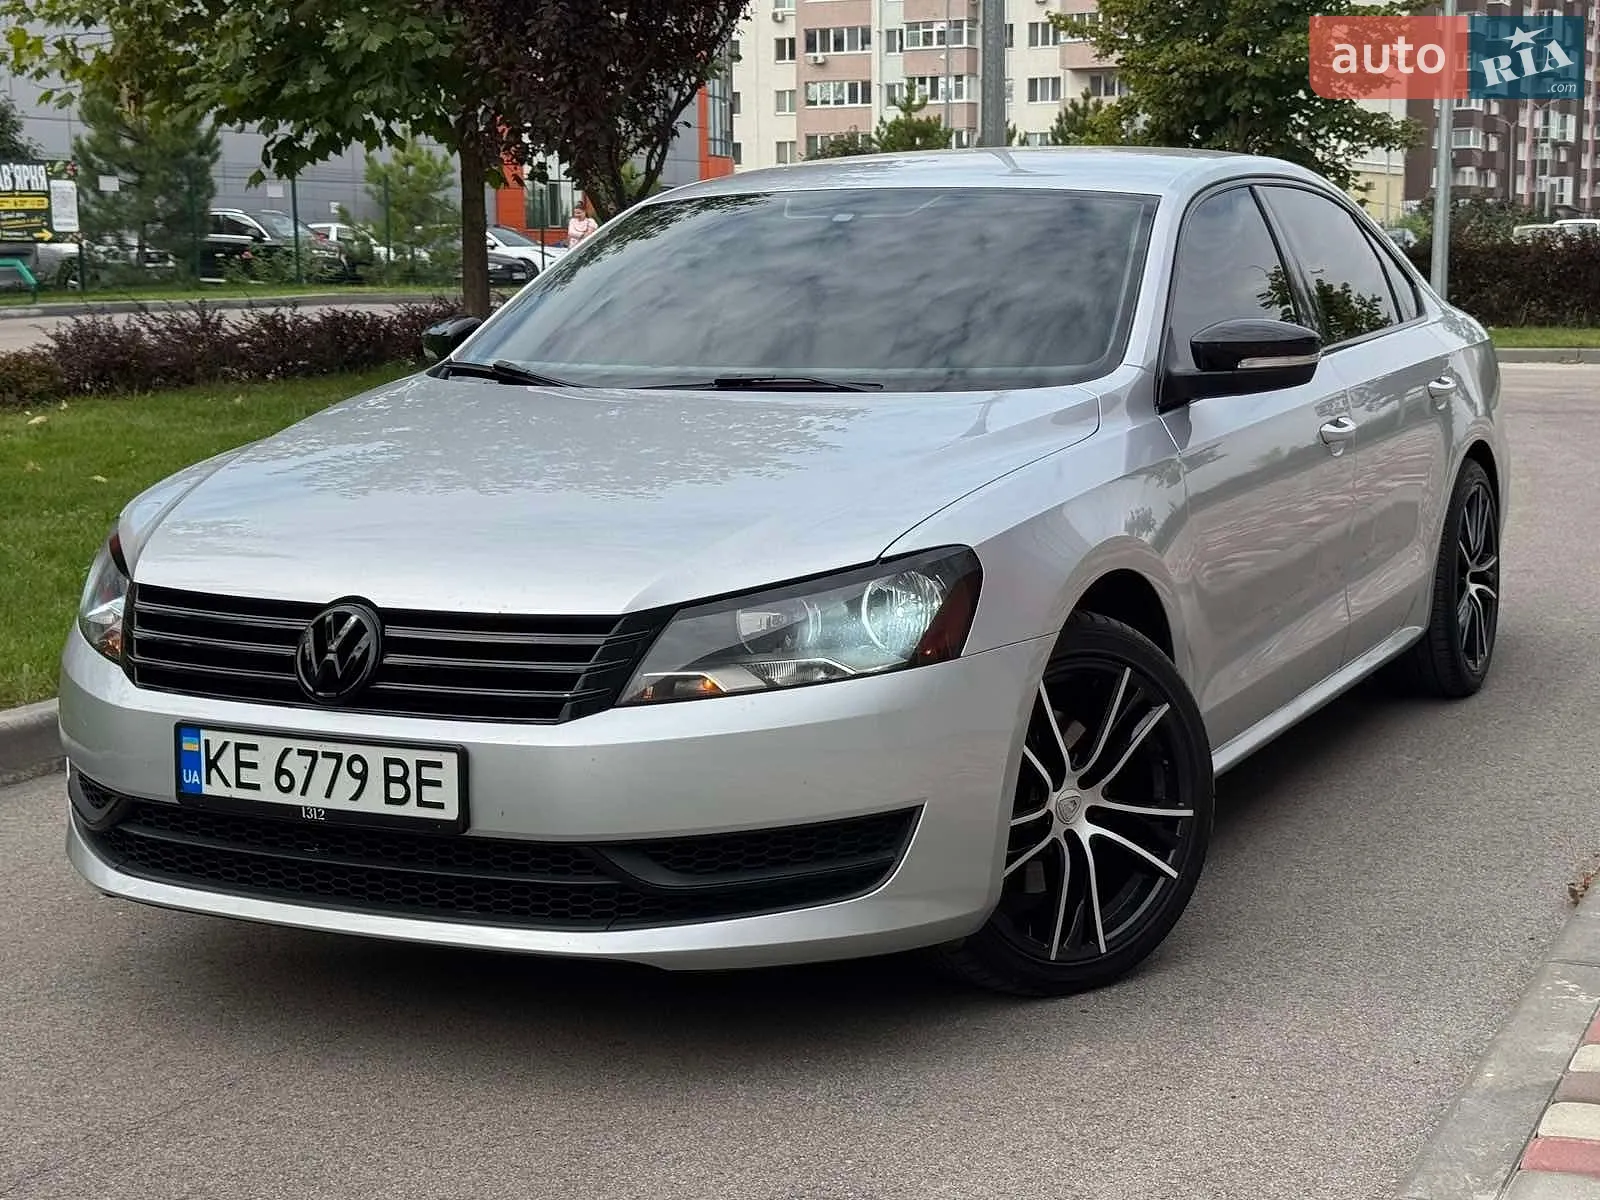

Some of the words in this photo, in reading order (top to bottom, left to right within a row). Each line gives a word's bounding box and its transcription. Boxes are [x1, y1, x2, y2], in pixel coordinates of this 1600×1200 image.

[183, 768, 201, 785] UA
[203, 738, 261, 791] KE
[274, 747, 369, 801] 6779
[383, 756, 445, 810] BE
